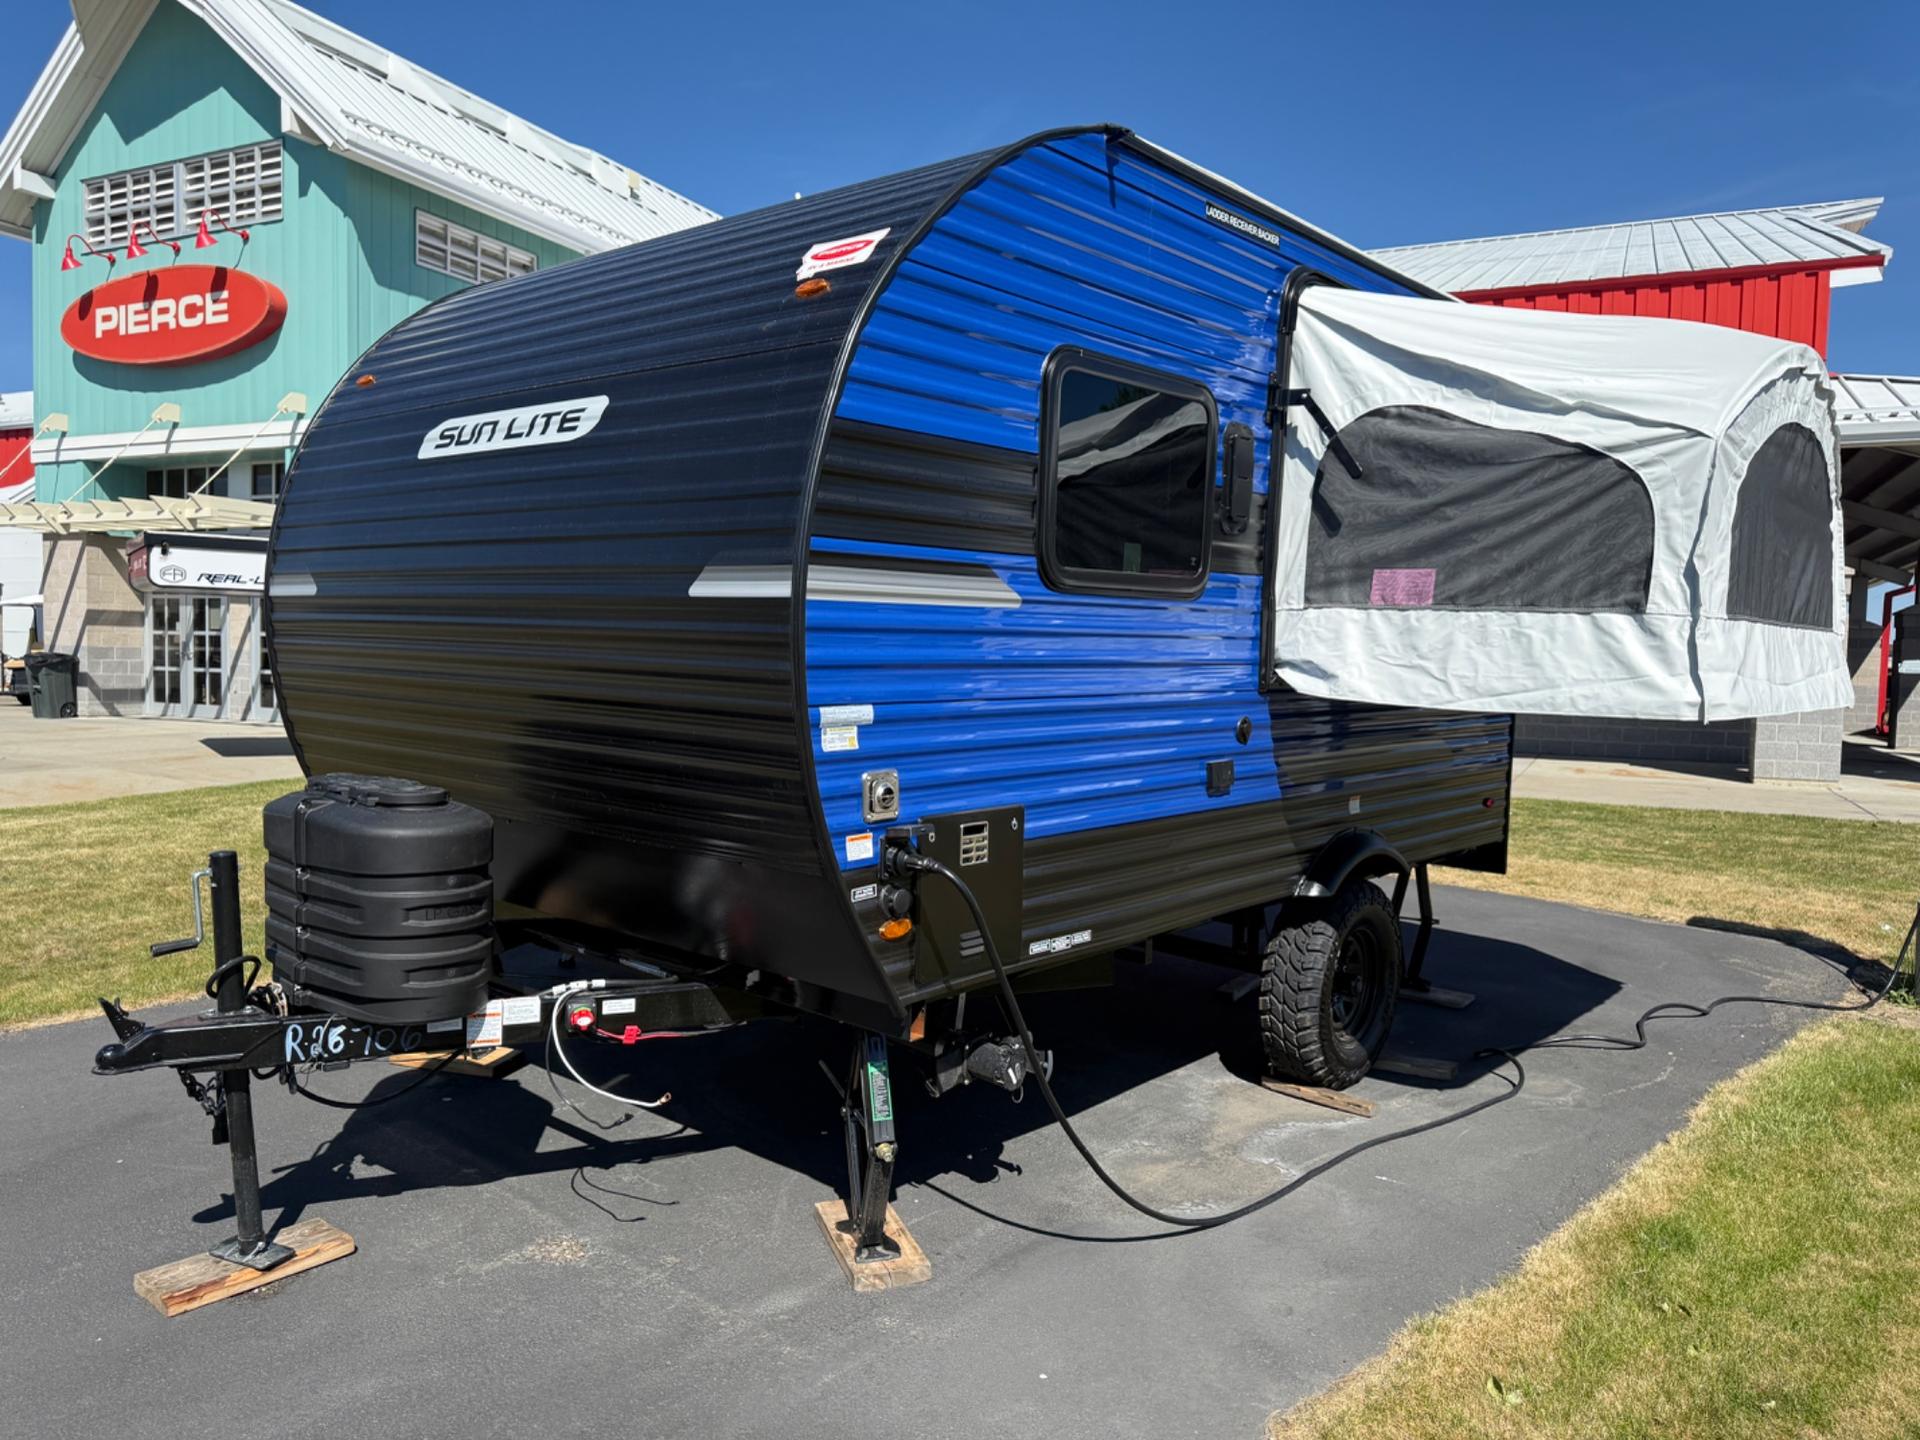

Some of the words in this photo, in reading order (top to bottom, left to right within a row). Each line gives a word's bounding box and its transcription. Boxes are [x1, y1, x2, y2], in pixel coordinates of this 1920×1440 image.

[95, 290, 230, 339] PIERCE
[433, 419, 500, 450] SUN
[503, 406, 588, 441] LITE
